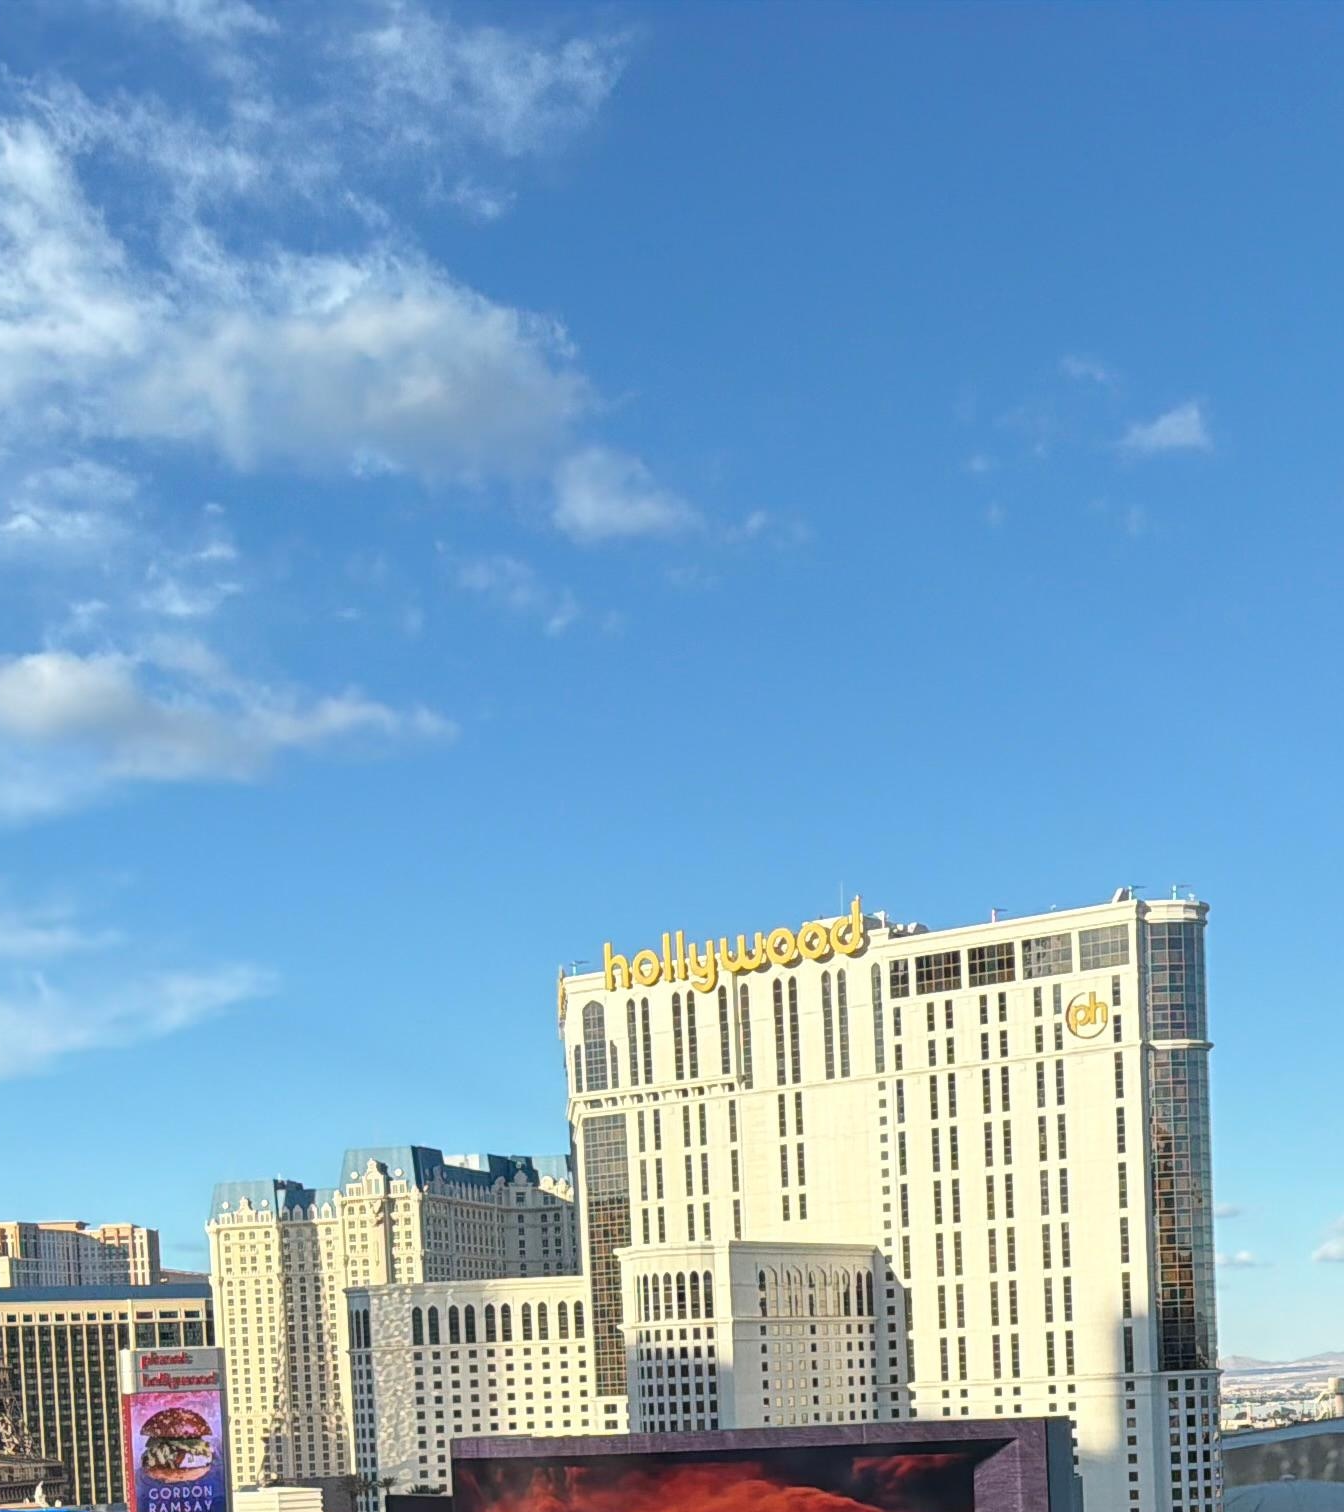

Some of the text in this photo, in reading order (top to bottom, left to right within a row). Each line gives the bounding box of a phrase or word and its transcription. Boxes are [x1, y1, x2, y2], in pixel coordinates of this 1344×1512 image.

[603, 896, 862, 993] hollywood
[141, 1371, 220, 1389] hollywood
[148, 1485, 212, 1500] GORDON
